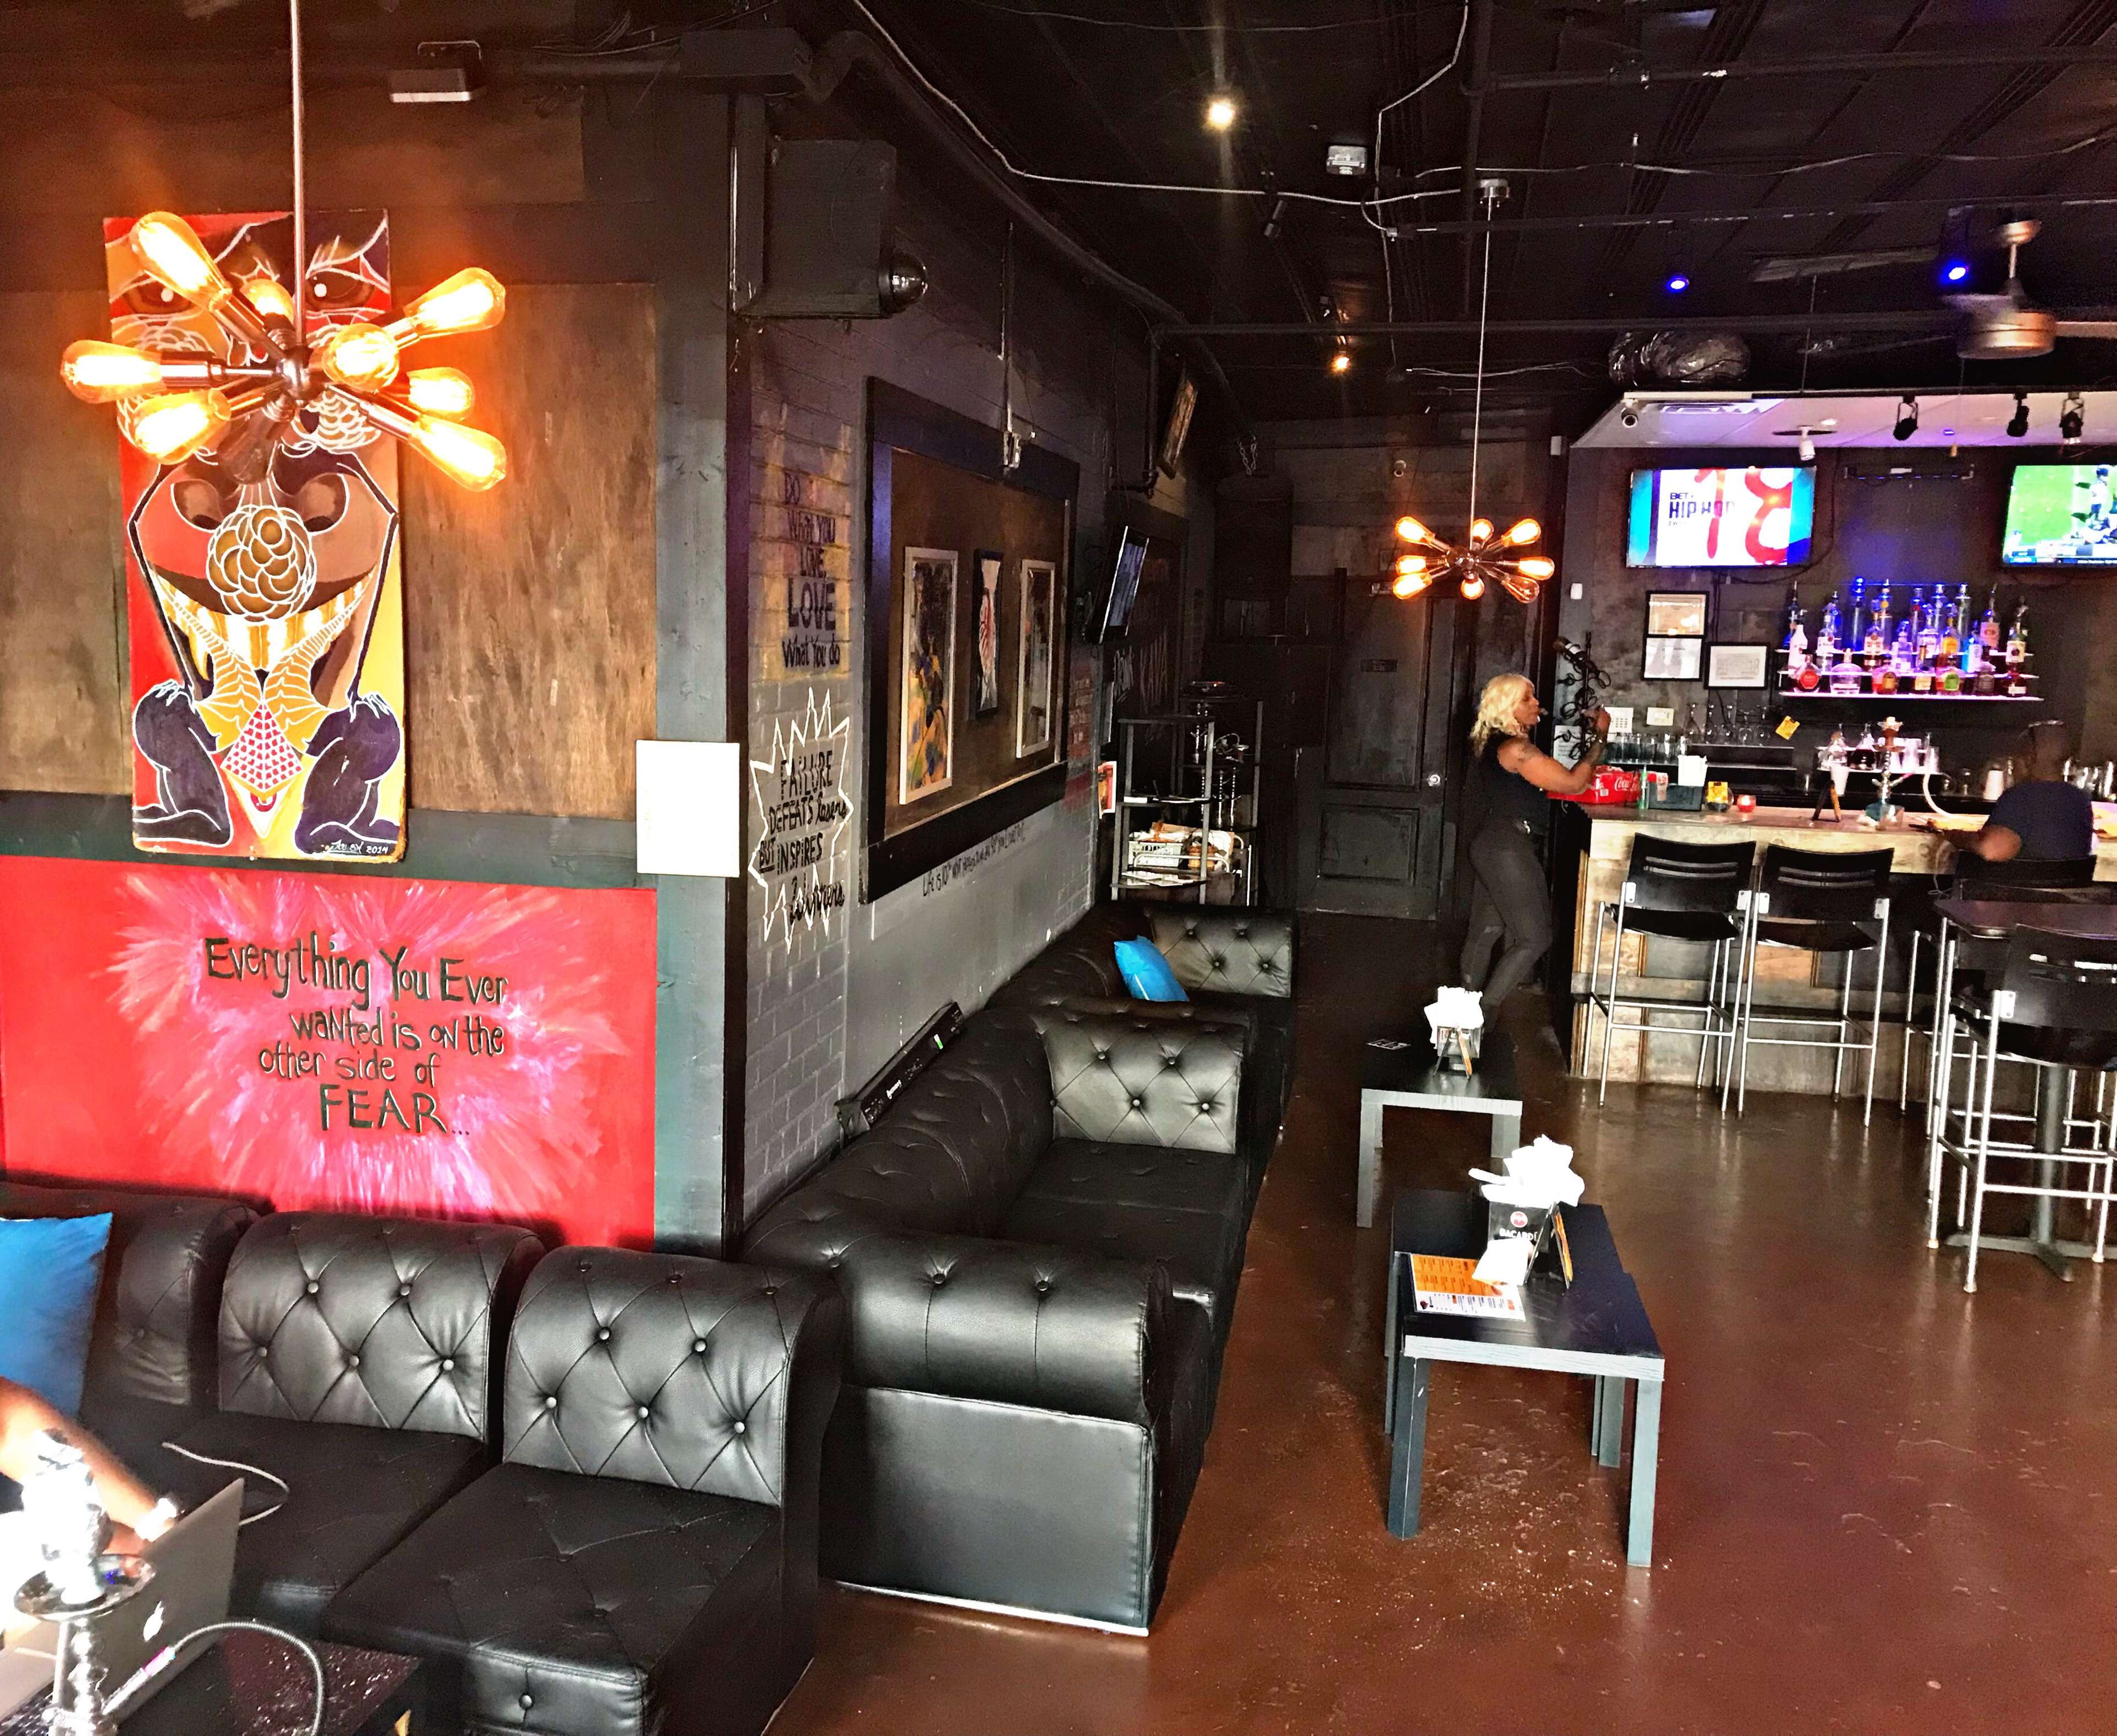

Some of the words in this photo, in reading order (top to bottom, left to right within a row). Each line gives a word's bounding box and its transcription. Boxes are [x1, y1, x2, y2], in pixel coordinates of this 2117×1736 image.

[785, 471, 800, 505] DO
[1669, 501, 1696, 518] HIP
[788, 577, 836, 631] LOVE
[782, 633, 810, 668] What
[810, 635, 827, 668] You
[829, 633, 840, 665] do
[759, 836, 776, 869] BUT
[205, 931, 370, 1010] Everything
[379, 945, 430, 1001] You
[439, 957, 508, 1006] Ever
[391, 1012, 422, 1051] is
[463, 1015, 505, 1058] the
[259, 1040, 326, 1081] other
[335, 1053, 396, 1081] side
[414, 1052, 440, 1089] of
